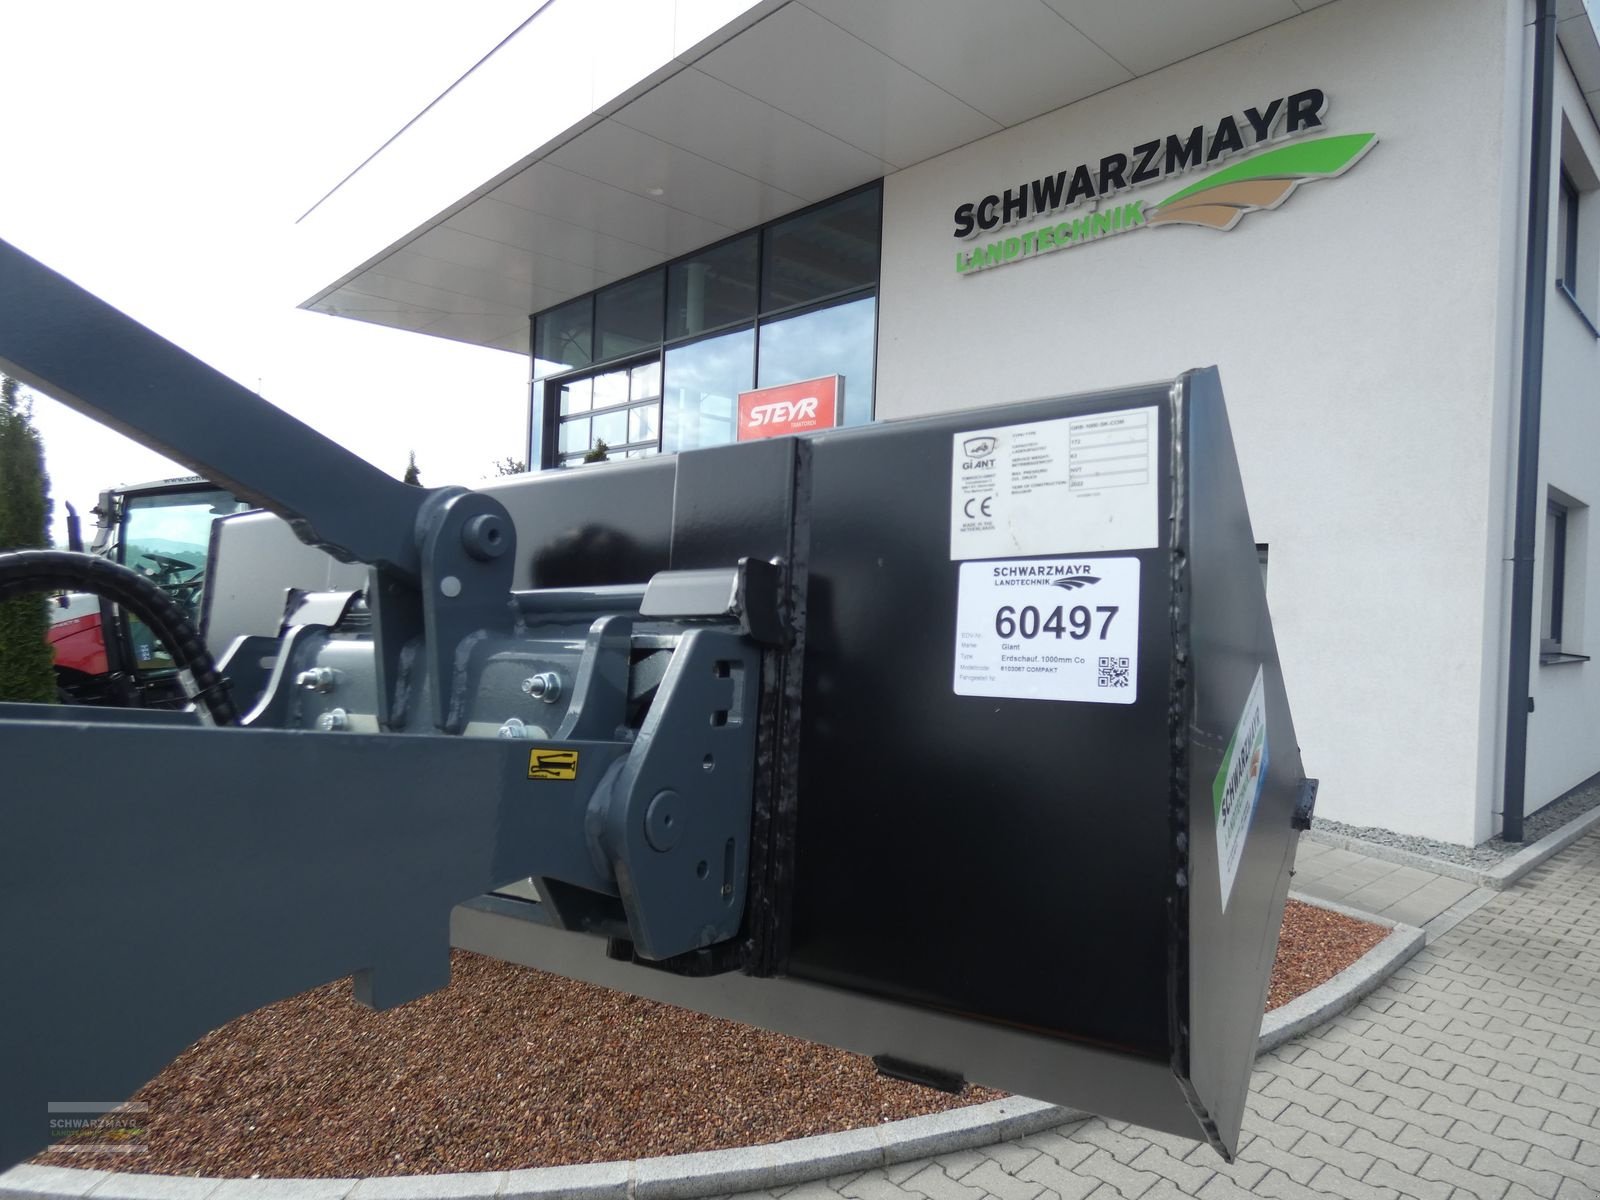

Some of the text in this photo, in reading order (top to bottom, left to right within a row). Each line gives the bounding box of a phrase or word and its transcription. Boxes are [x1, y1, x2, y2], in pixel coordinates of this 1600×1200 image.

[953, 88, 1326, 239] SCHWARZMAYR
[955, 199, 1147, 274] LANDTECHNIK
[748, 397, 818, 427] STEYR
[964, 496, 992, 519] CE
[993, 565, 1091, 577] SCHWARZMAYR
[994, 578, 1051, 586] LANDTECHNIK
[995, 605, 1120, 640] 60497
[1001, 643, 1021, 651] Giant
[1001, 654, 1040, 662] Erdschauf.
[1041, 655, 1073, 663] 1000mm
[1074, 656, 1086, 664] Co
